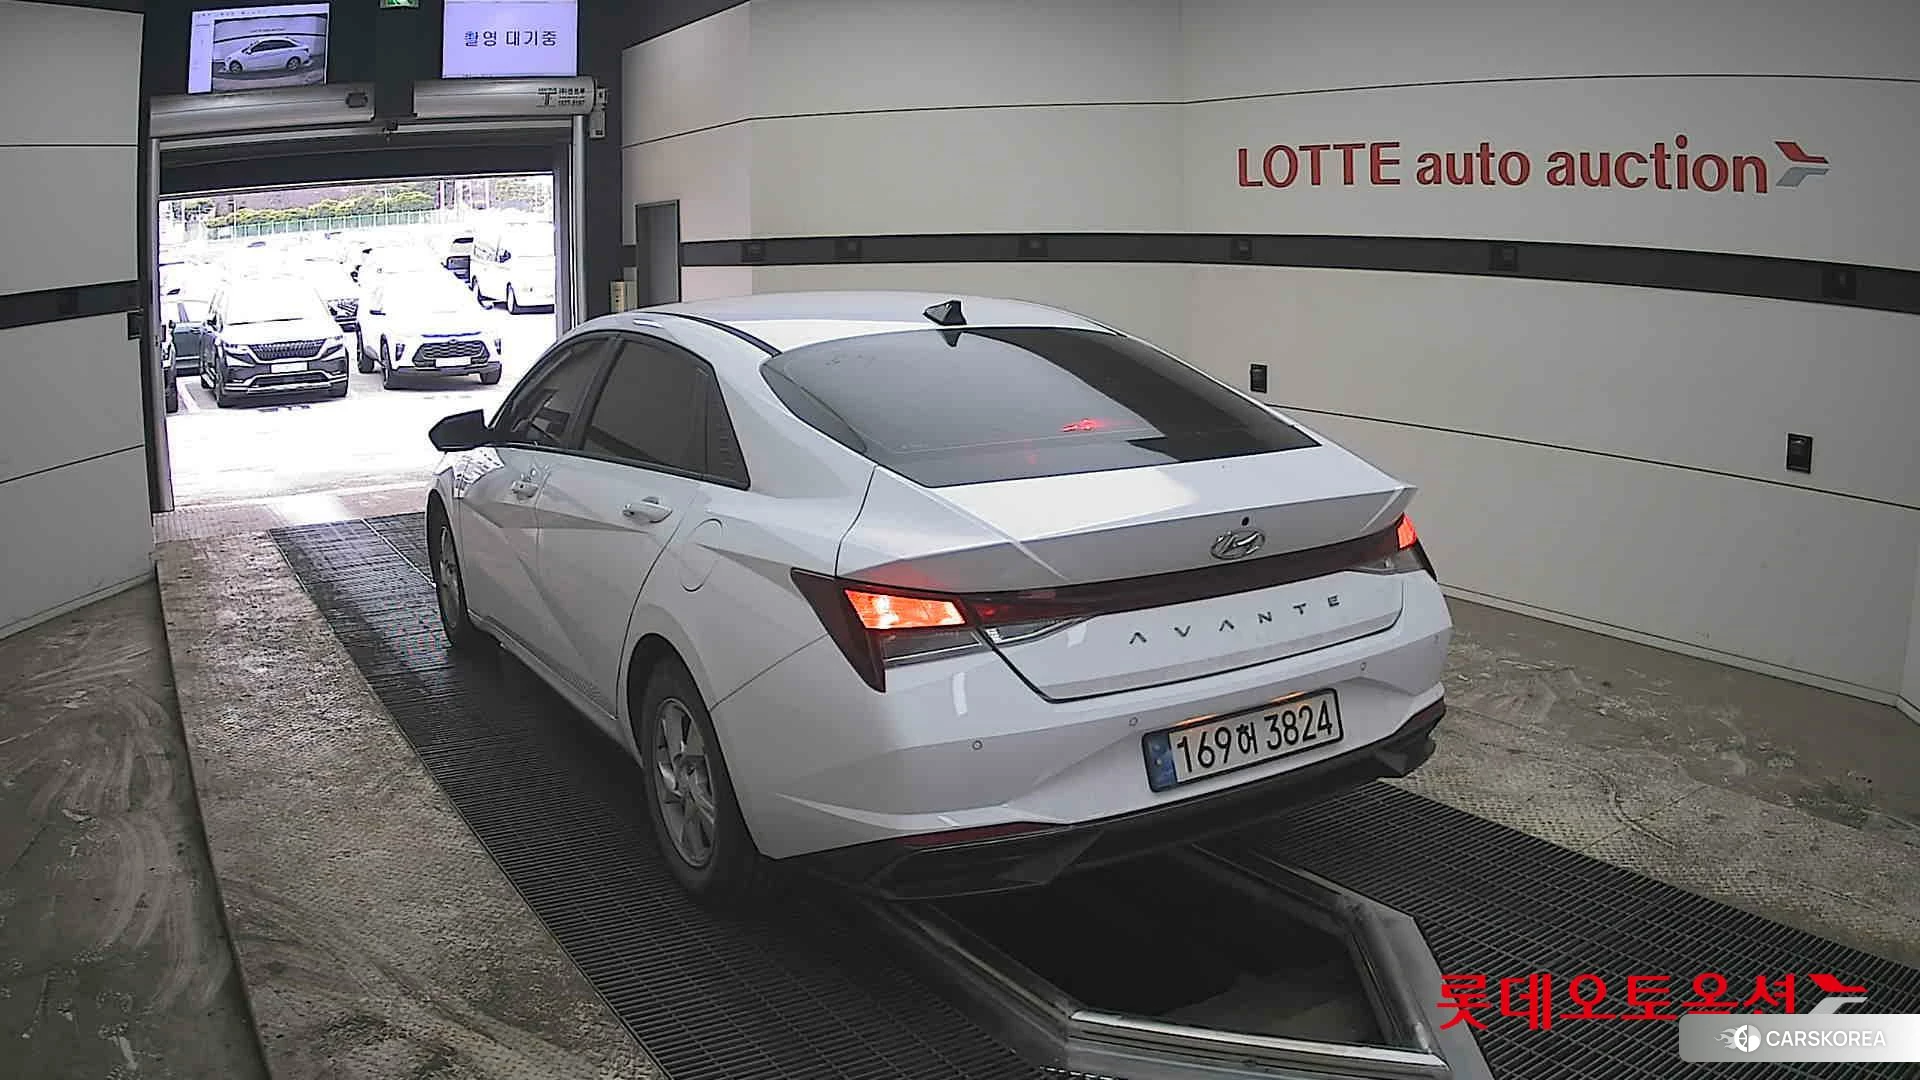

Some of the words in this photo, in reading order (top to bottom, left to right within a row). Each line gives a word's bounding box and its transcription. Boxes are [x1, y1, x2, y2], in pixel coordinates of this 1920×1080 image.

[506, 30, 556, 46] 대기중
[1237, 141, 1400, 188] LOTTE
[1415, 141, 1531, 187] auto
[1544, 134, 1768, 194] auction
[1129, 595, 1340, 644] AVANTE
[1264, 700, 1333, 751] 3824
